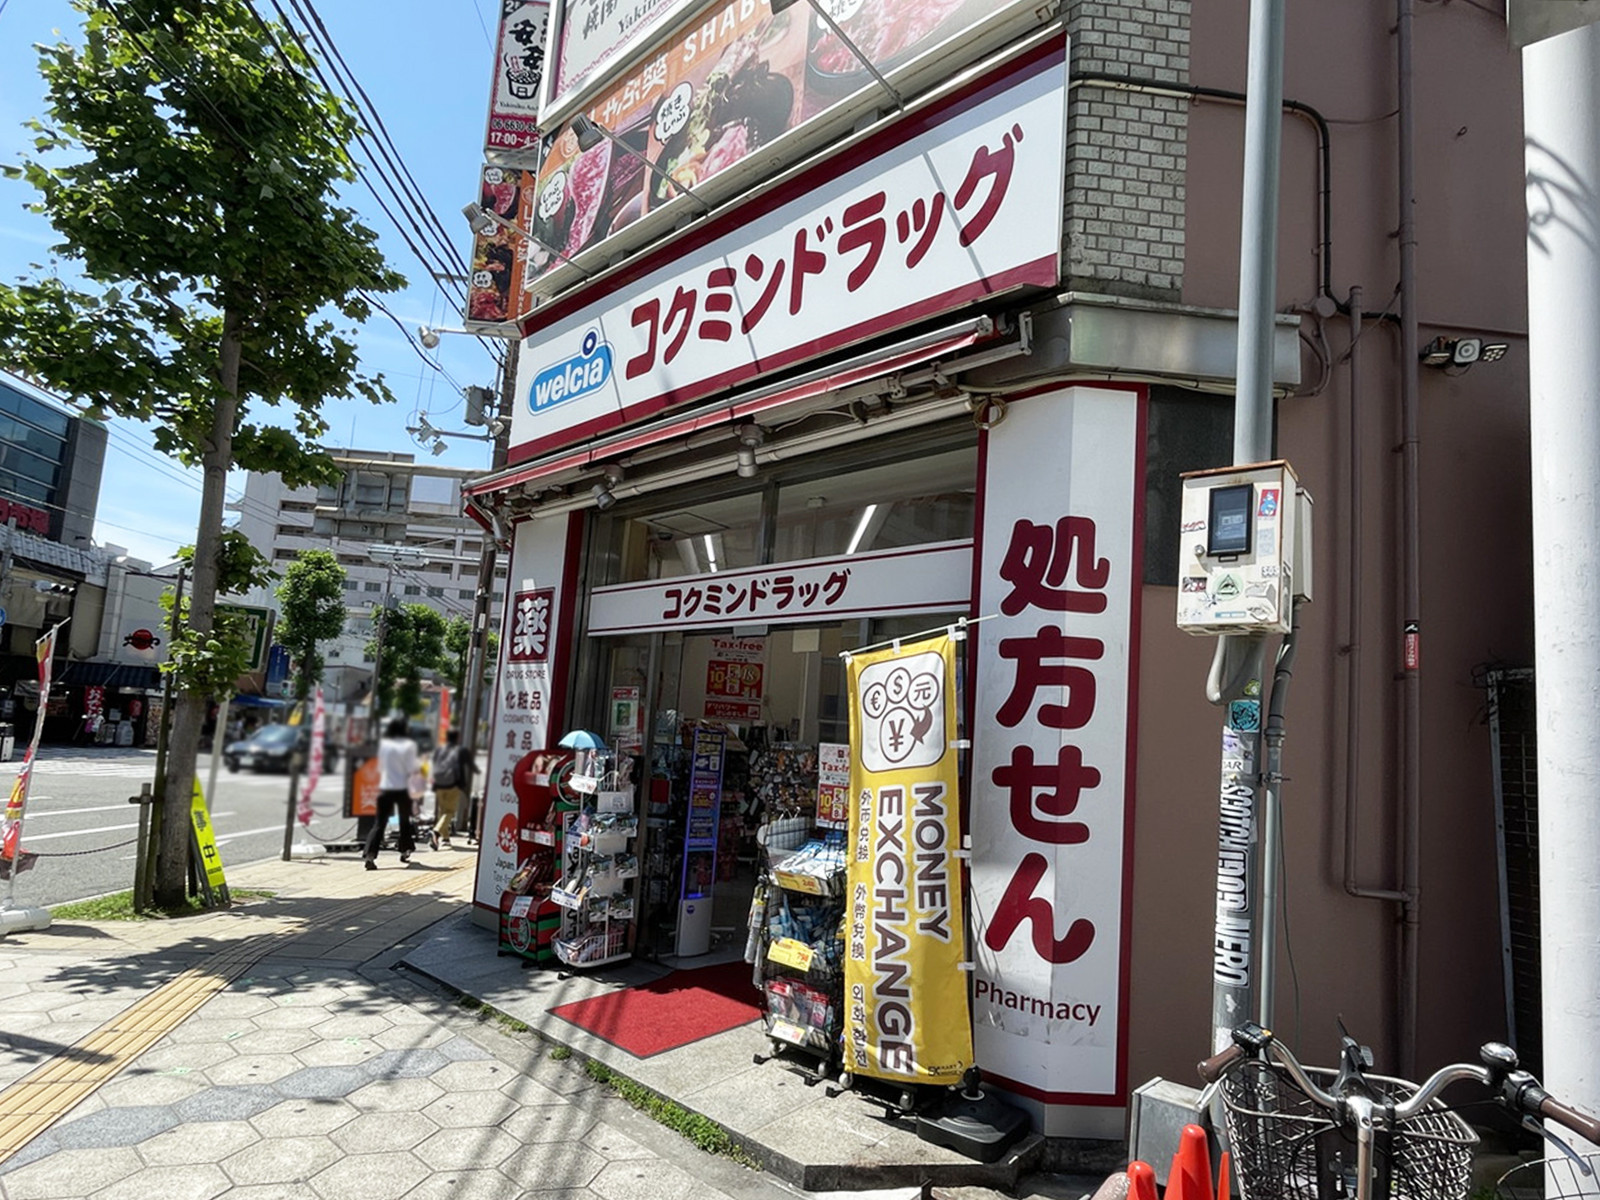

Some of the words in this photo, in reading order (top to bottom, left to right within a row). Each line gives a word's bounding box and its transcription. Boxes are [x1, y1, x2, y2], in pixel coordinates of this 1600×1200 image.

[683, 0, 770, 63] SHAB
[626, 122, 1024, 381] コクミンドラッグ
[535, 356, 604, 408] welcia
[663, 568, 851, 619] コクミンドラッグ
[513, 598, 549, 655] 薬
[984, 515, 1111, 965] 処方せん
[913, 784, 950, 941] MONEY
[873, 788, 915, 1075] EXCHANGE
[974, 978, 1101, 1027] Pharmacy
